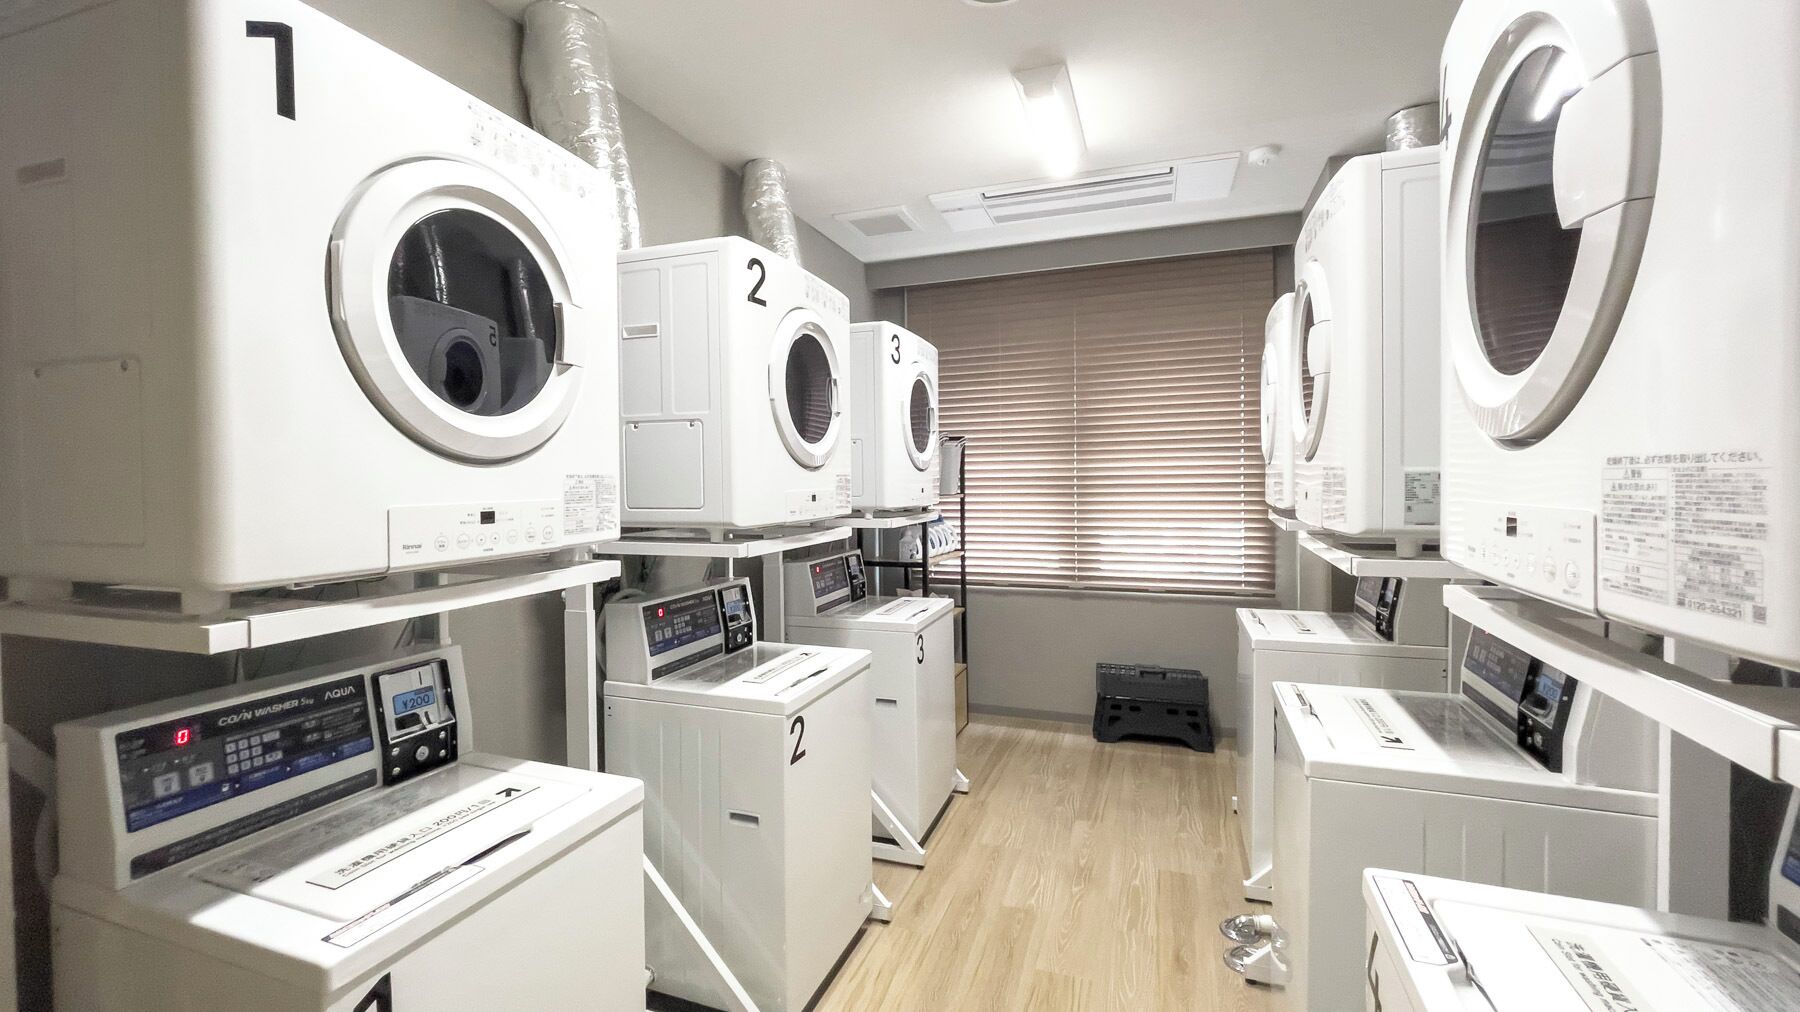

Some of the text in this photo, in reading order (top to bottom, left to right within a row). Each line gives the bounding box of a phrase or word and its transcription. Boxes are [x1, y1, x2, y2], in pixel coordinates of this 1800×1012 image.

[246, 20, 296, 121] 1
[747, 257, 768, 307] 2
[891, 334, 901, 365] 3
[915, 633, 925, 665] 3
[254, 699, 299, 719] WASHER
[325, 686, 356, 701] AQUA
[176, 728, 189, 745] 0
[789, 715, 807, 766] 2
